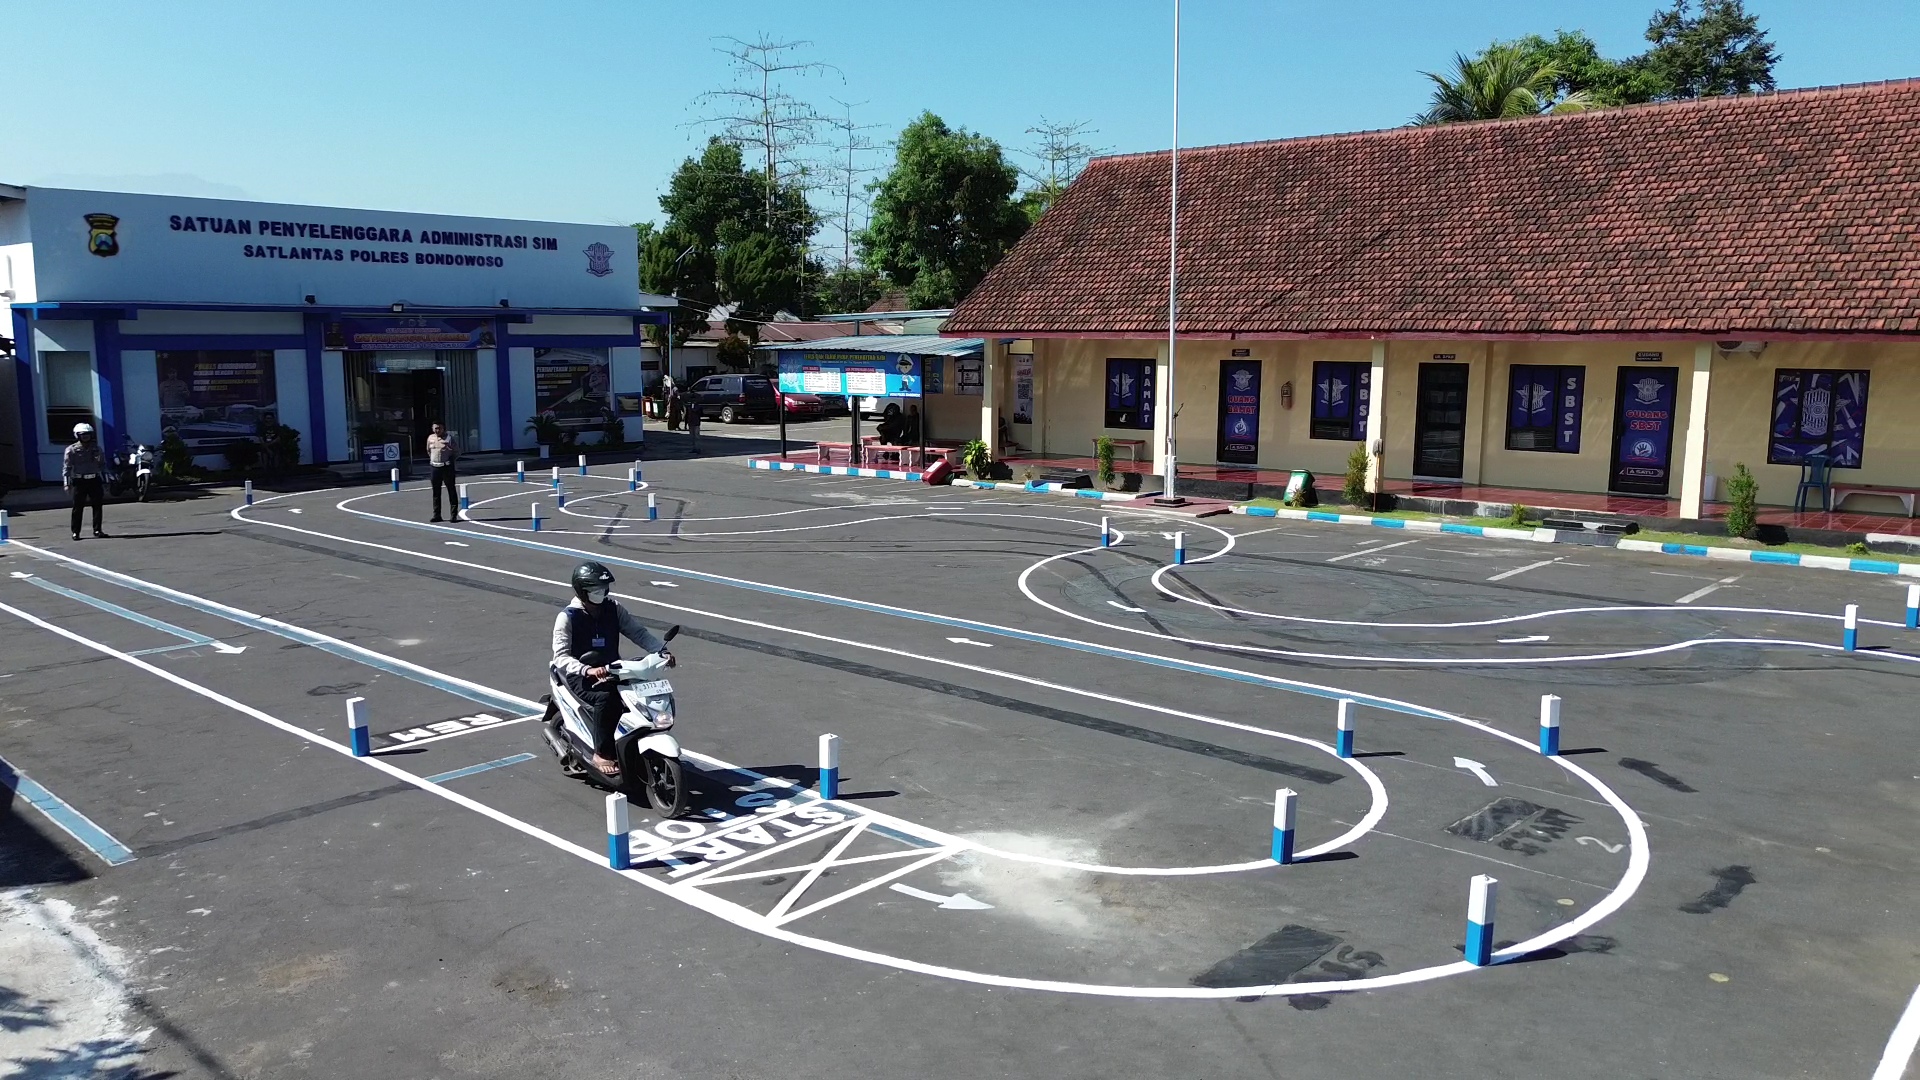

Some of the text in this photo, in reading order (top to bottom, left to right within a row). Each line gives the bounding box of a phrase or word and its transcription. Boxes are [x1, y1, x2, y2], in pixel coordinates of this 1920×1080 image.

[169, 215, 558, 251] SATUAN PENYELENGGARA ADMINISTRASI SIM
[243, 245, 504, 268] SATLANTAS POLRES BONDOWOSO
[1227, 395, 1256, 404] RUANG
[1563, 377, 1577, 443] SBST
[1625, 409, 1668, 419] GUDANG
[1630, 420, 1662, 431] SBST
[389, 713, 503, 742] REM
[656, 803, 845, 879] START
